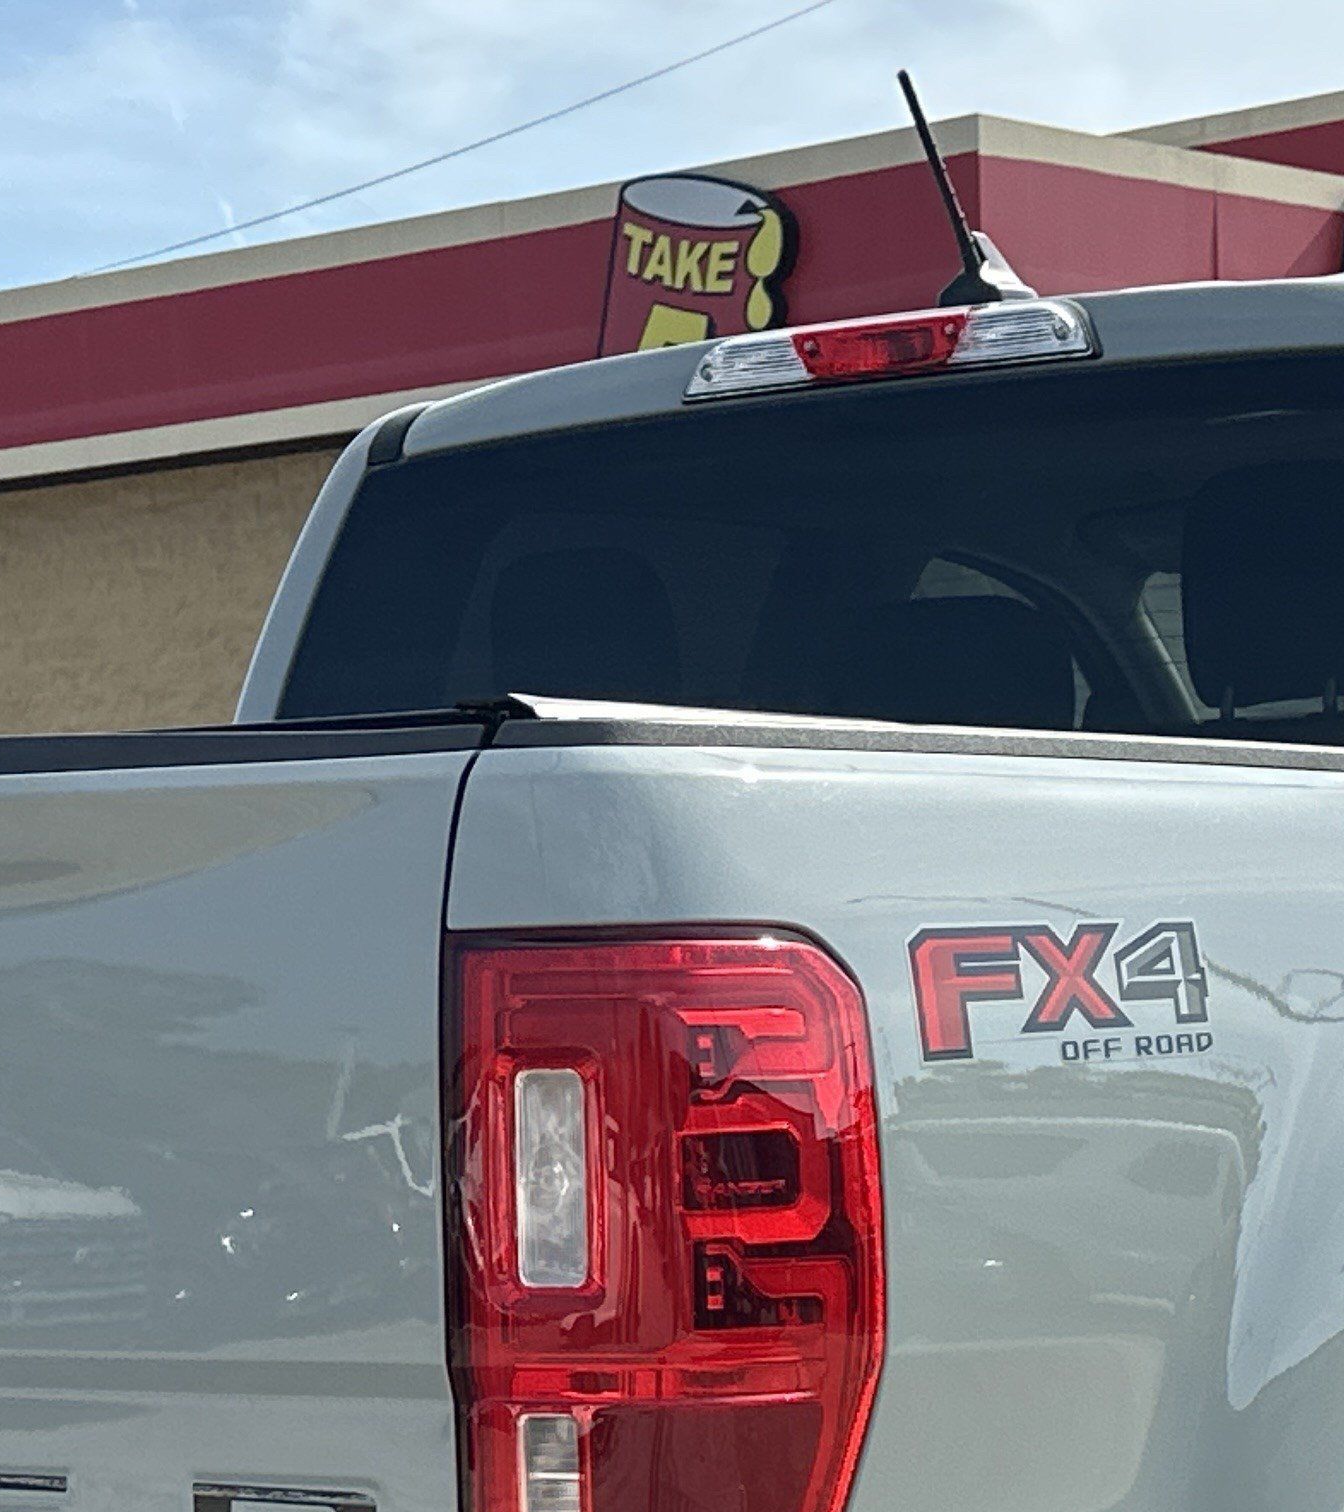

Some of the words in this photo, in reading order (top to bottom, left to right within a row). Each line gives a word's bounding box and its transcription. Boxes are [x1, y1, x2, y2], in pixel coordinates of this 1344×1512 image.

[623, 222, 739, 293] TAKE
[907, 918, 1208, 1063] FX4
[1061, 1040, 1122, 1061] OFF
[1135, 1031, 1214, 1056] ROAD
